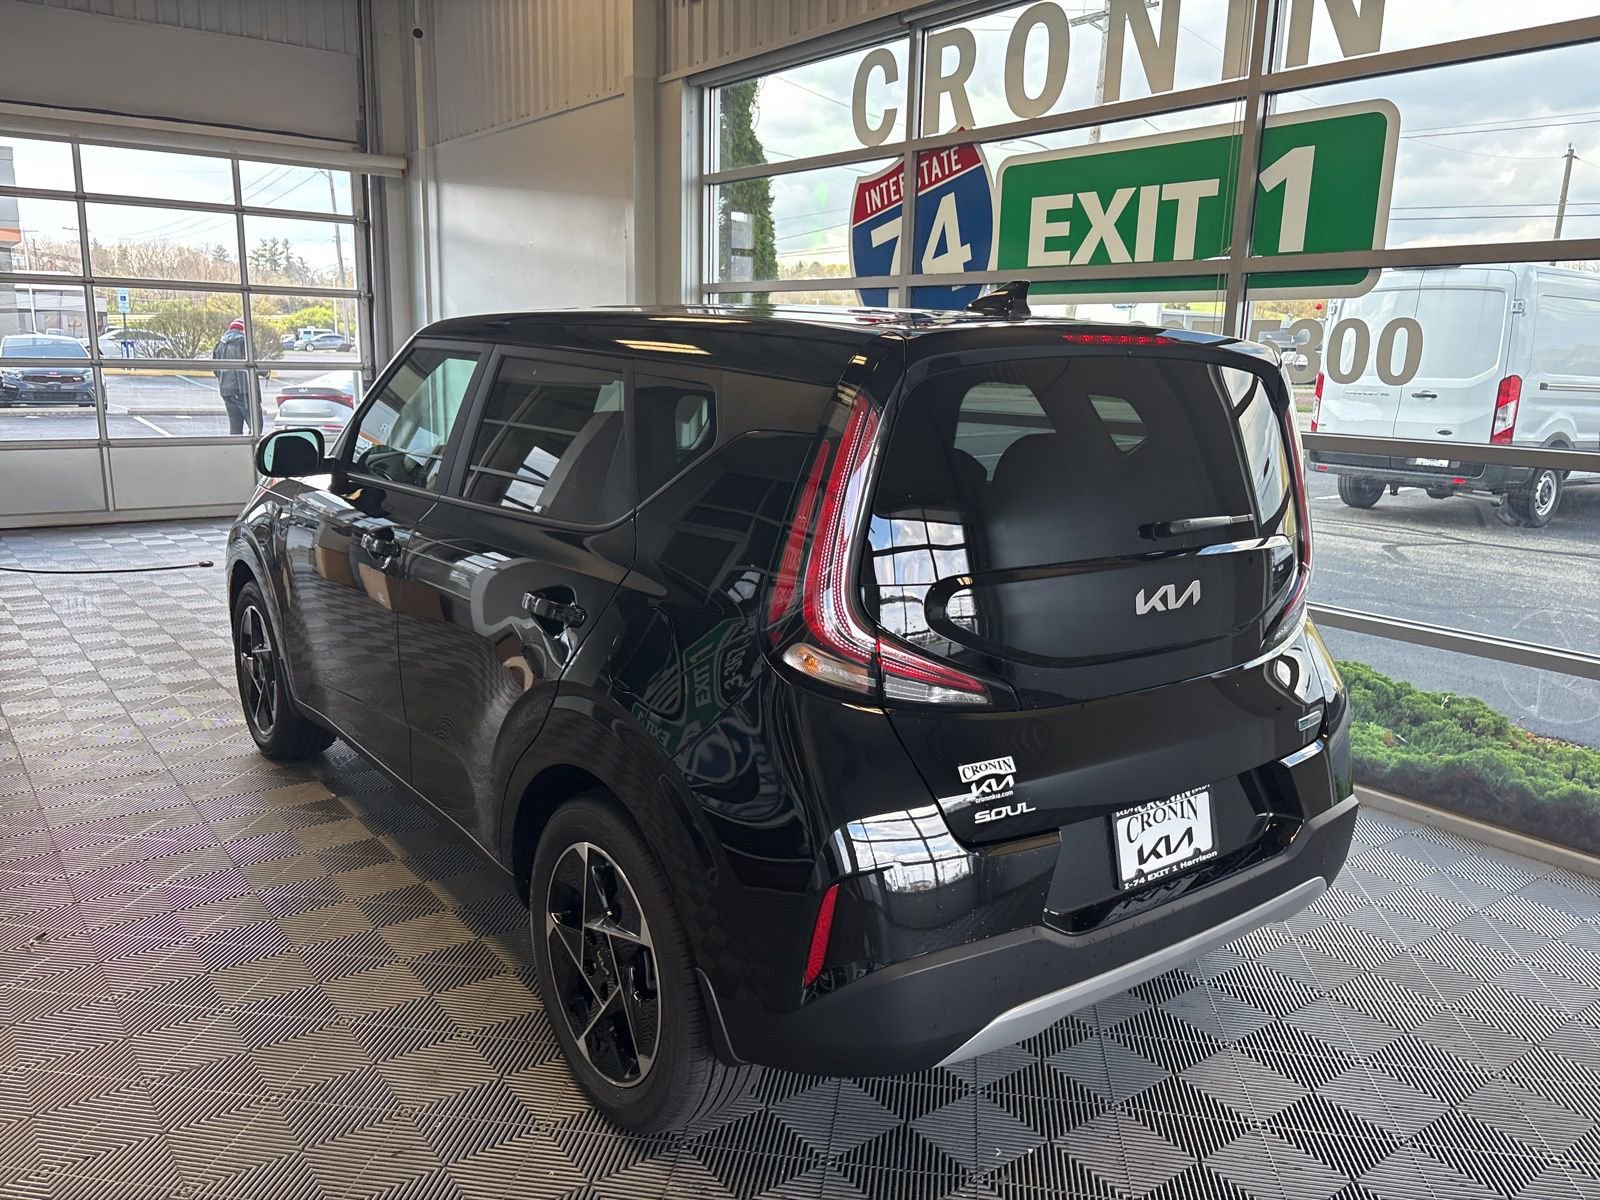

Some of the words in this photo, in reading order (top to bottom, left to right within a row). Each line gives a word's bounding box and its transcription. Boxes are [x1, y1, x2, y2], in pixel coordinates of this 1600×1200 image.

[865, 147, 962, 214] INTETATE
[1027, 178, 1220, 267] EXIT
[1259, 145, 1316, 253] 1
[870, 192, 973, 308] 74
[1135, 579, 1201, 616] KIA
[962, 758, 1013, 780] CRONIN
[970, 774, 1015, 797] KIA
[974, 801, 1037, 824] SOUL
[1126, 796, 1199, 844] CRONIN
[1136, 825, 1194, 866] KIA
[1123, 876, 1146, 890] I-74
[1147, 866, 1171, 882] EXIT
[1172, 864, 1179, 873] 1
[1180, 850, 1218, 868] Harrison
